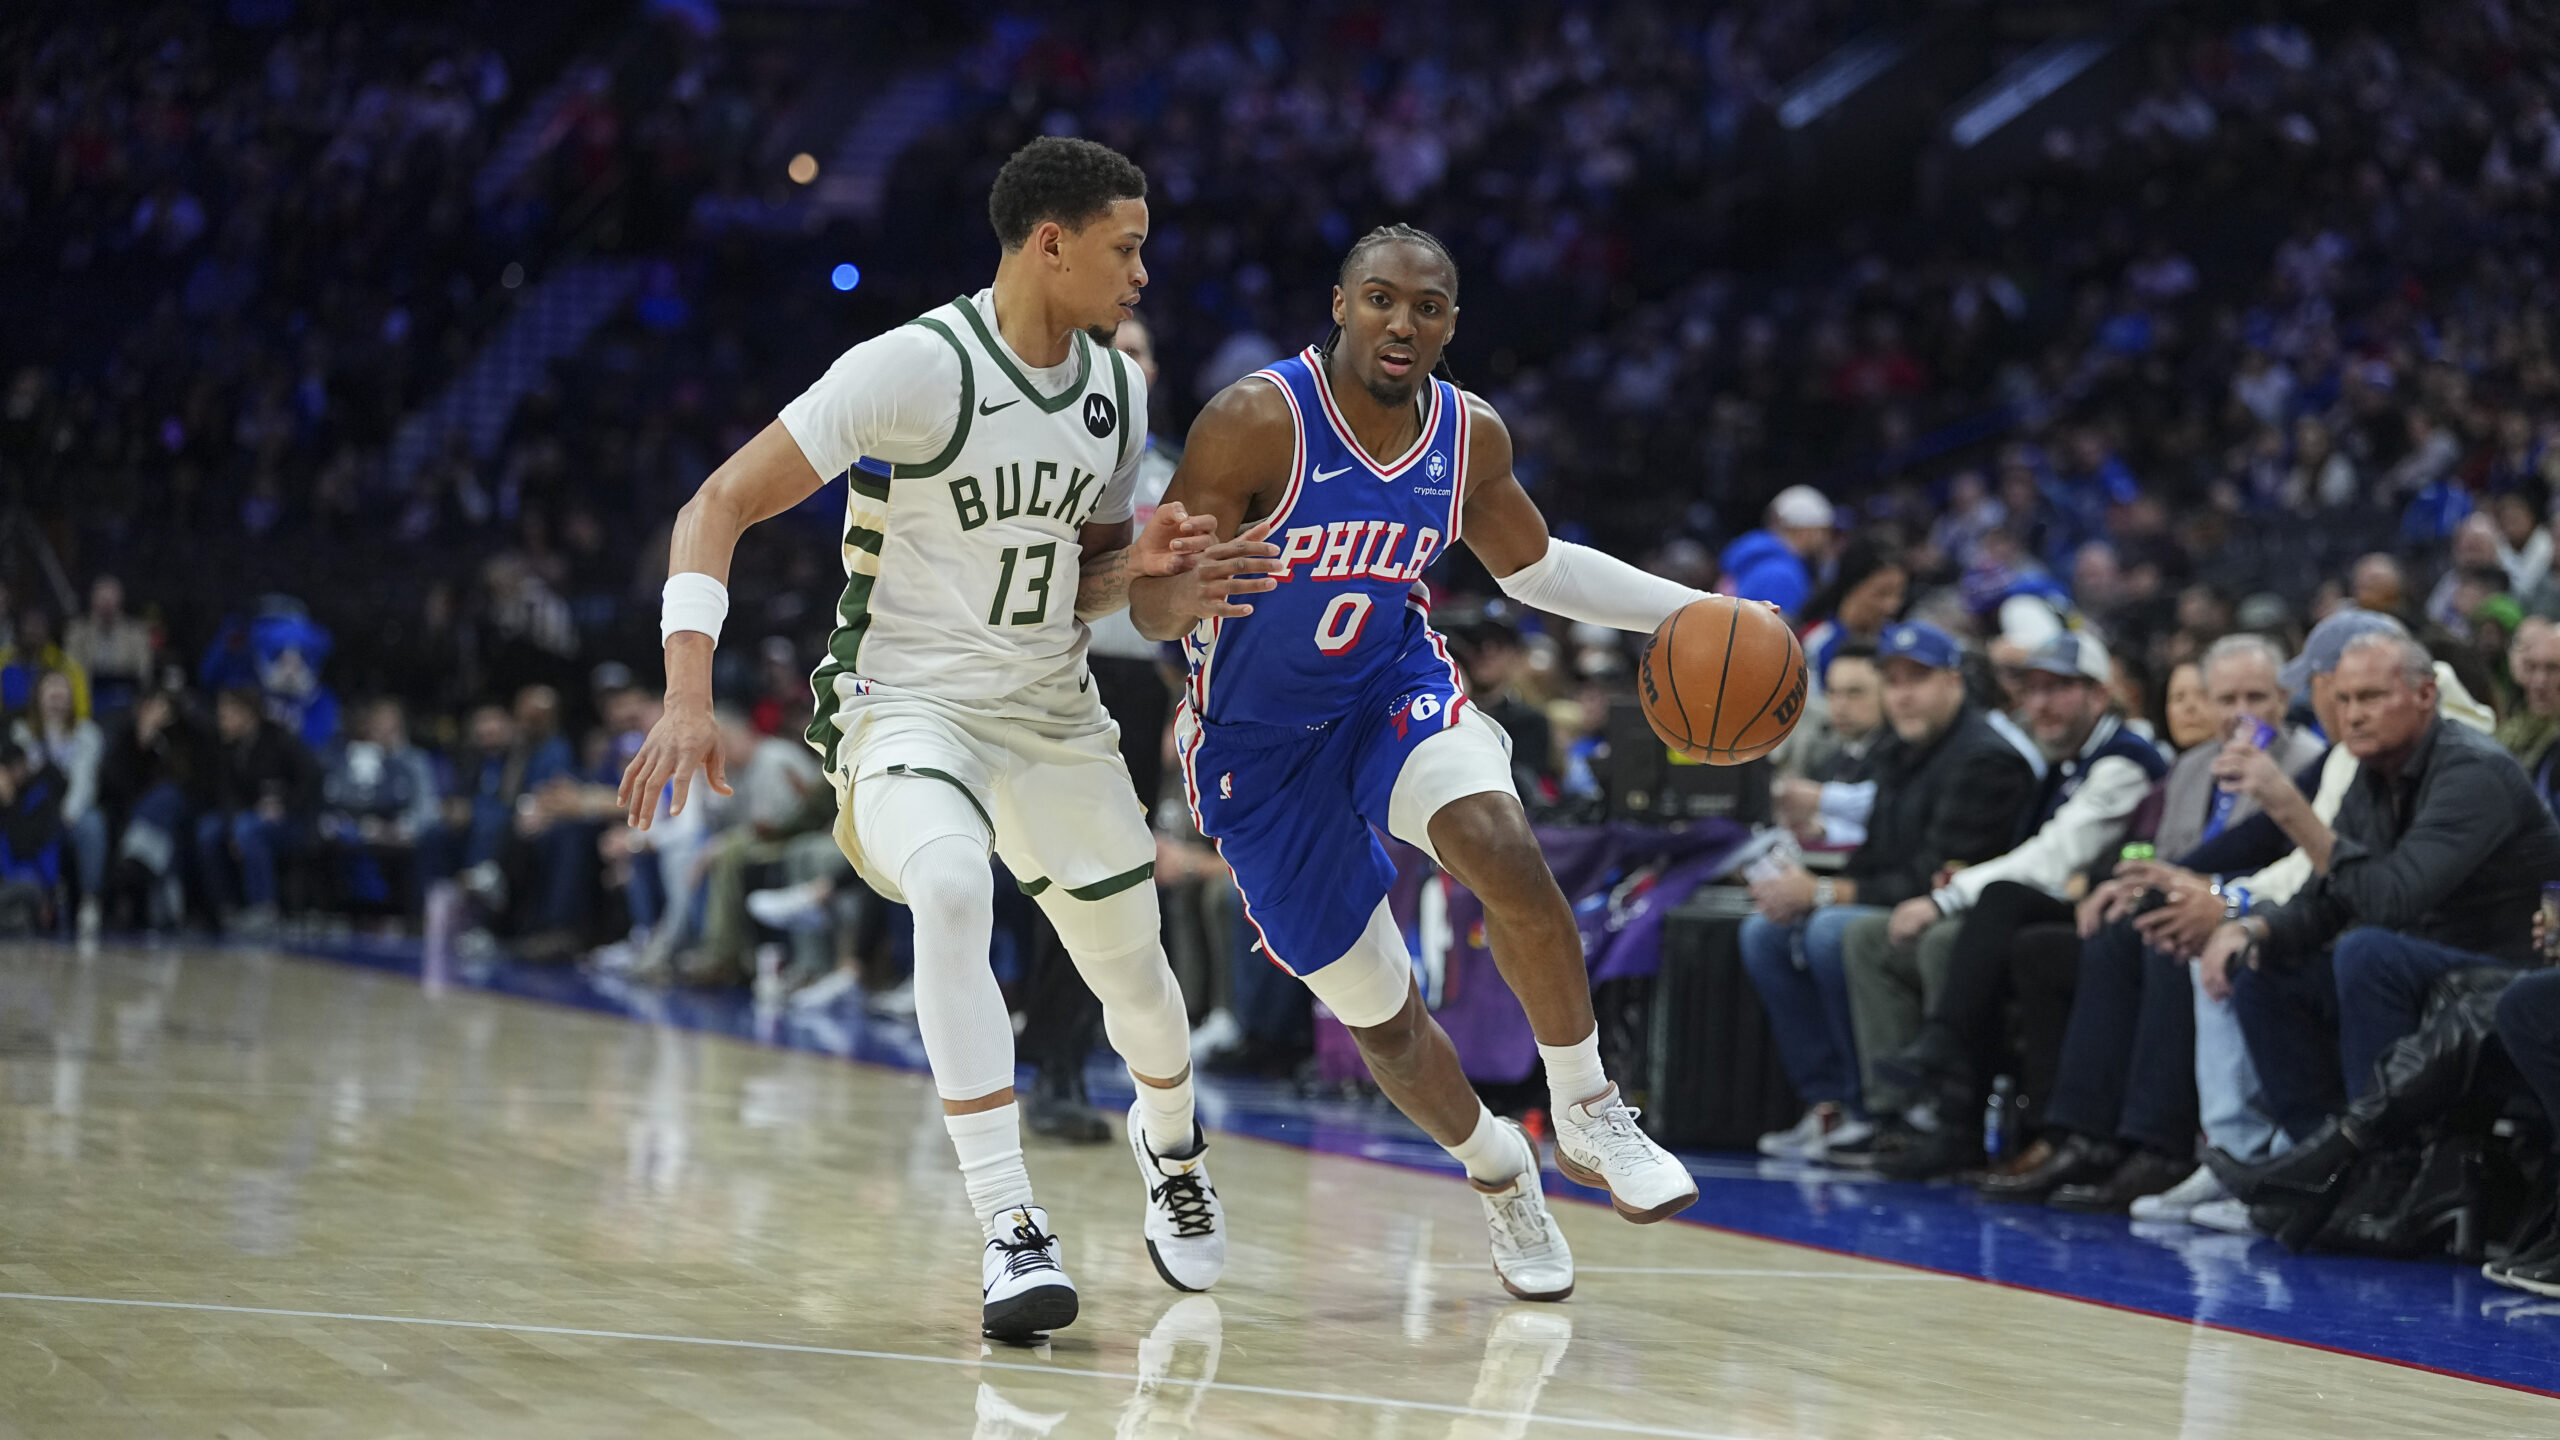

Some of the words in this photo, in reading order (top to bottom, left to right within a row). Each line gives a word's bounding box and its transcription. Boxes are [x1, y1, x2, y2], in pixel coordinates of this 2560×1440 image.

[1413, 486, 1451, 496] crypto.com
[1267, 520, 1441, 583] PHILA
[988, 541, 1057, 626] 13
[1314, 592, 1375, 657] 0
[1389, 693, 1441, 743] 76
[1772, 664, 1808, 725] Wil
